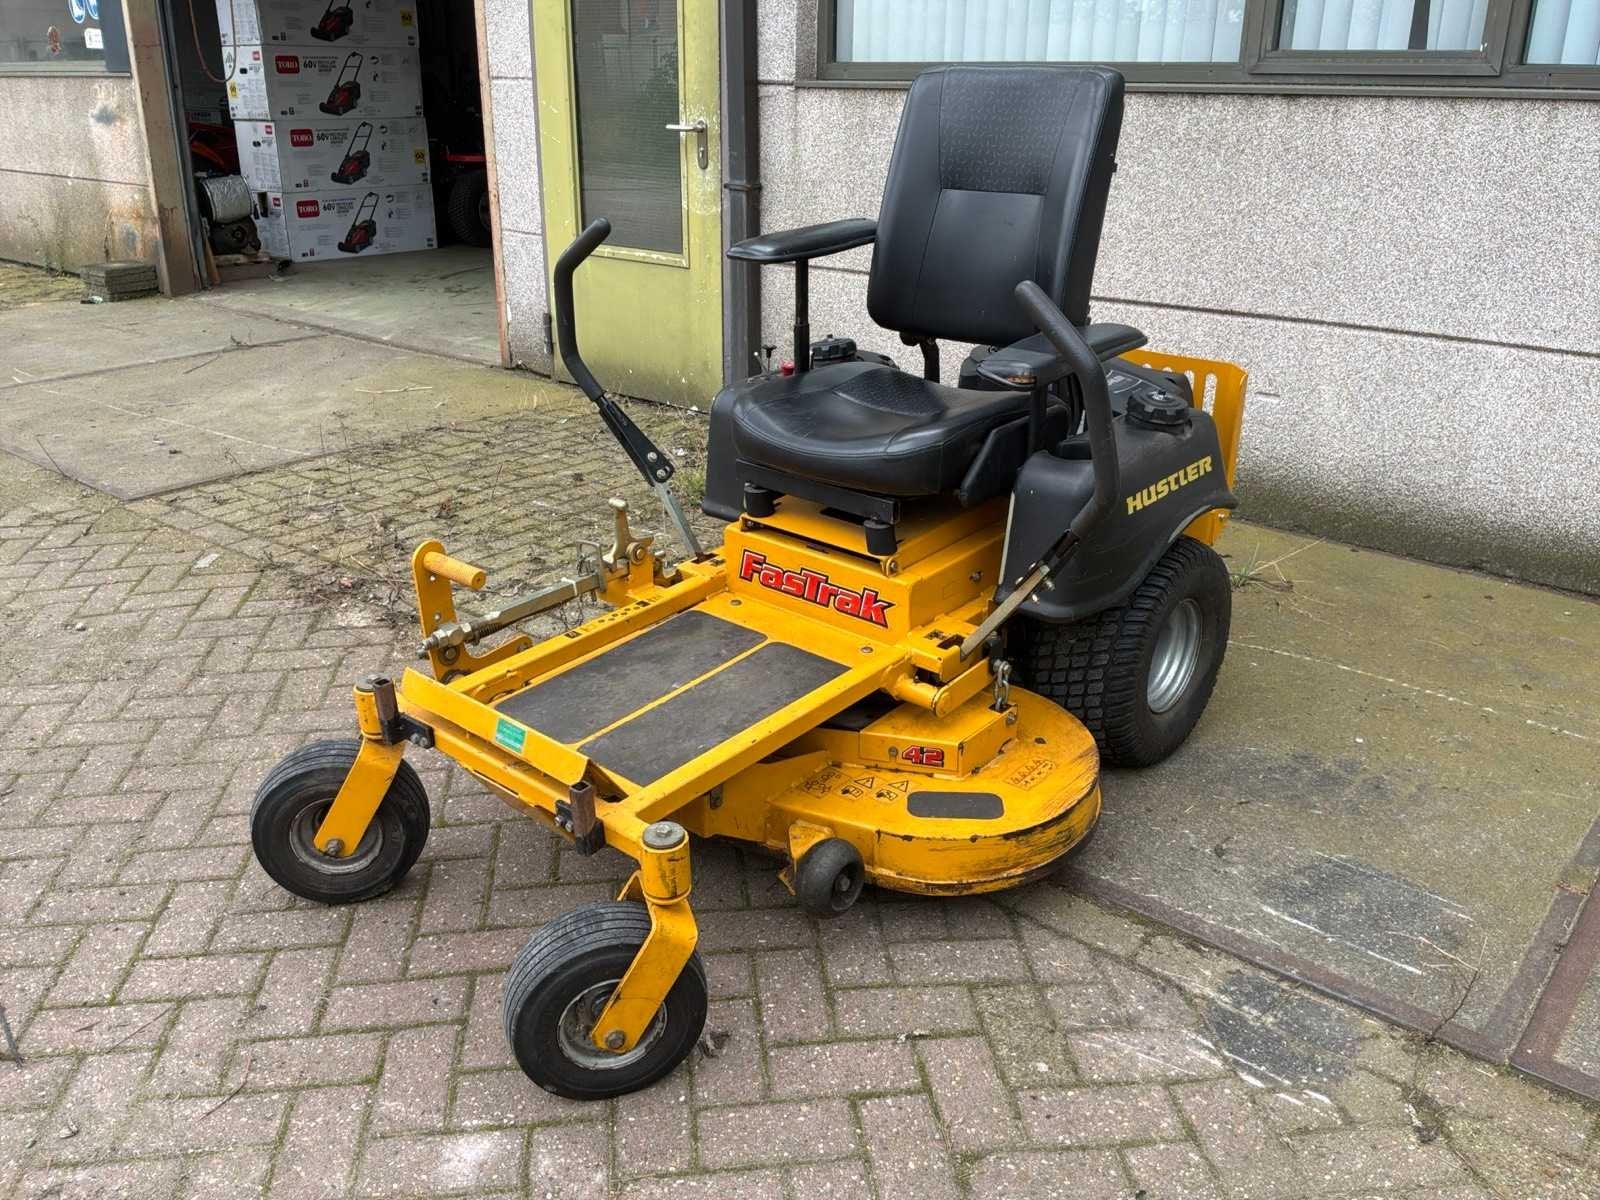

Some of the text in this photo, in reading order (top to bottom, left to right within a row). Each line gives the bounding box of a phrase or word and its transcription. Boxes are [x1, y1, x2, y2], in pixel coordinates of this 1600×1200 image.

[278, 60, 298, 69] TORO
[293, 134, 312, 143] TORO
[299, 204, 318, 213] TORO
[1126, 455, 1213, 516] HUSTLER
[739, 549, 896, 629] FasTrak
[902, 745, 944, 768] 42
